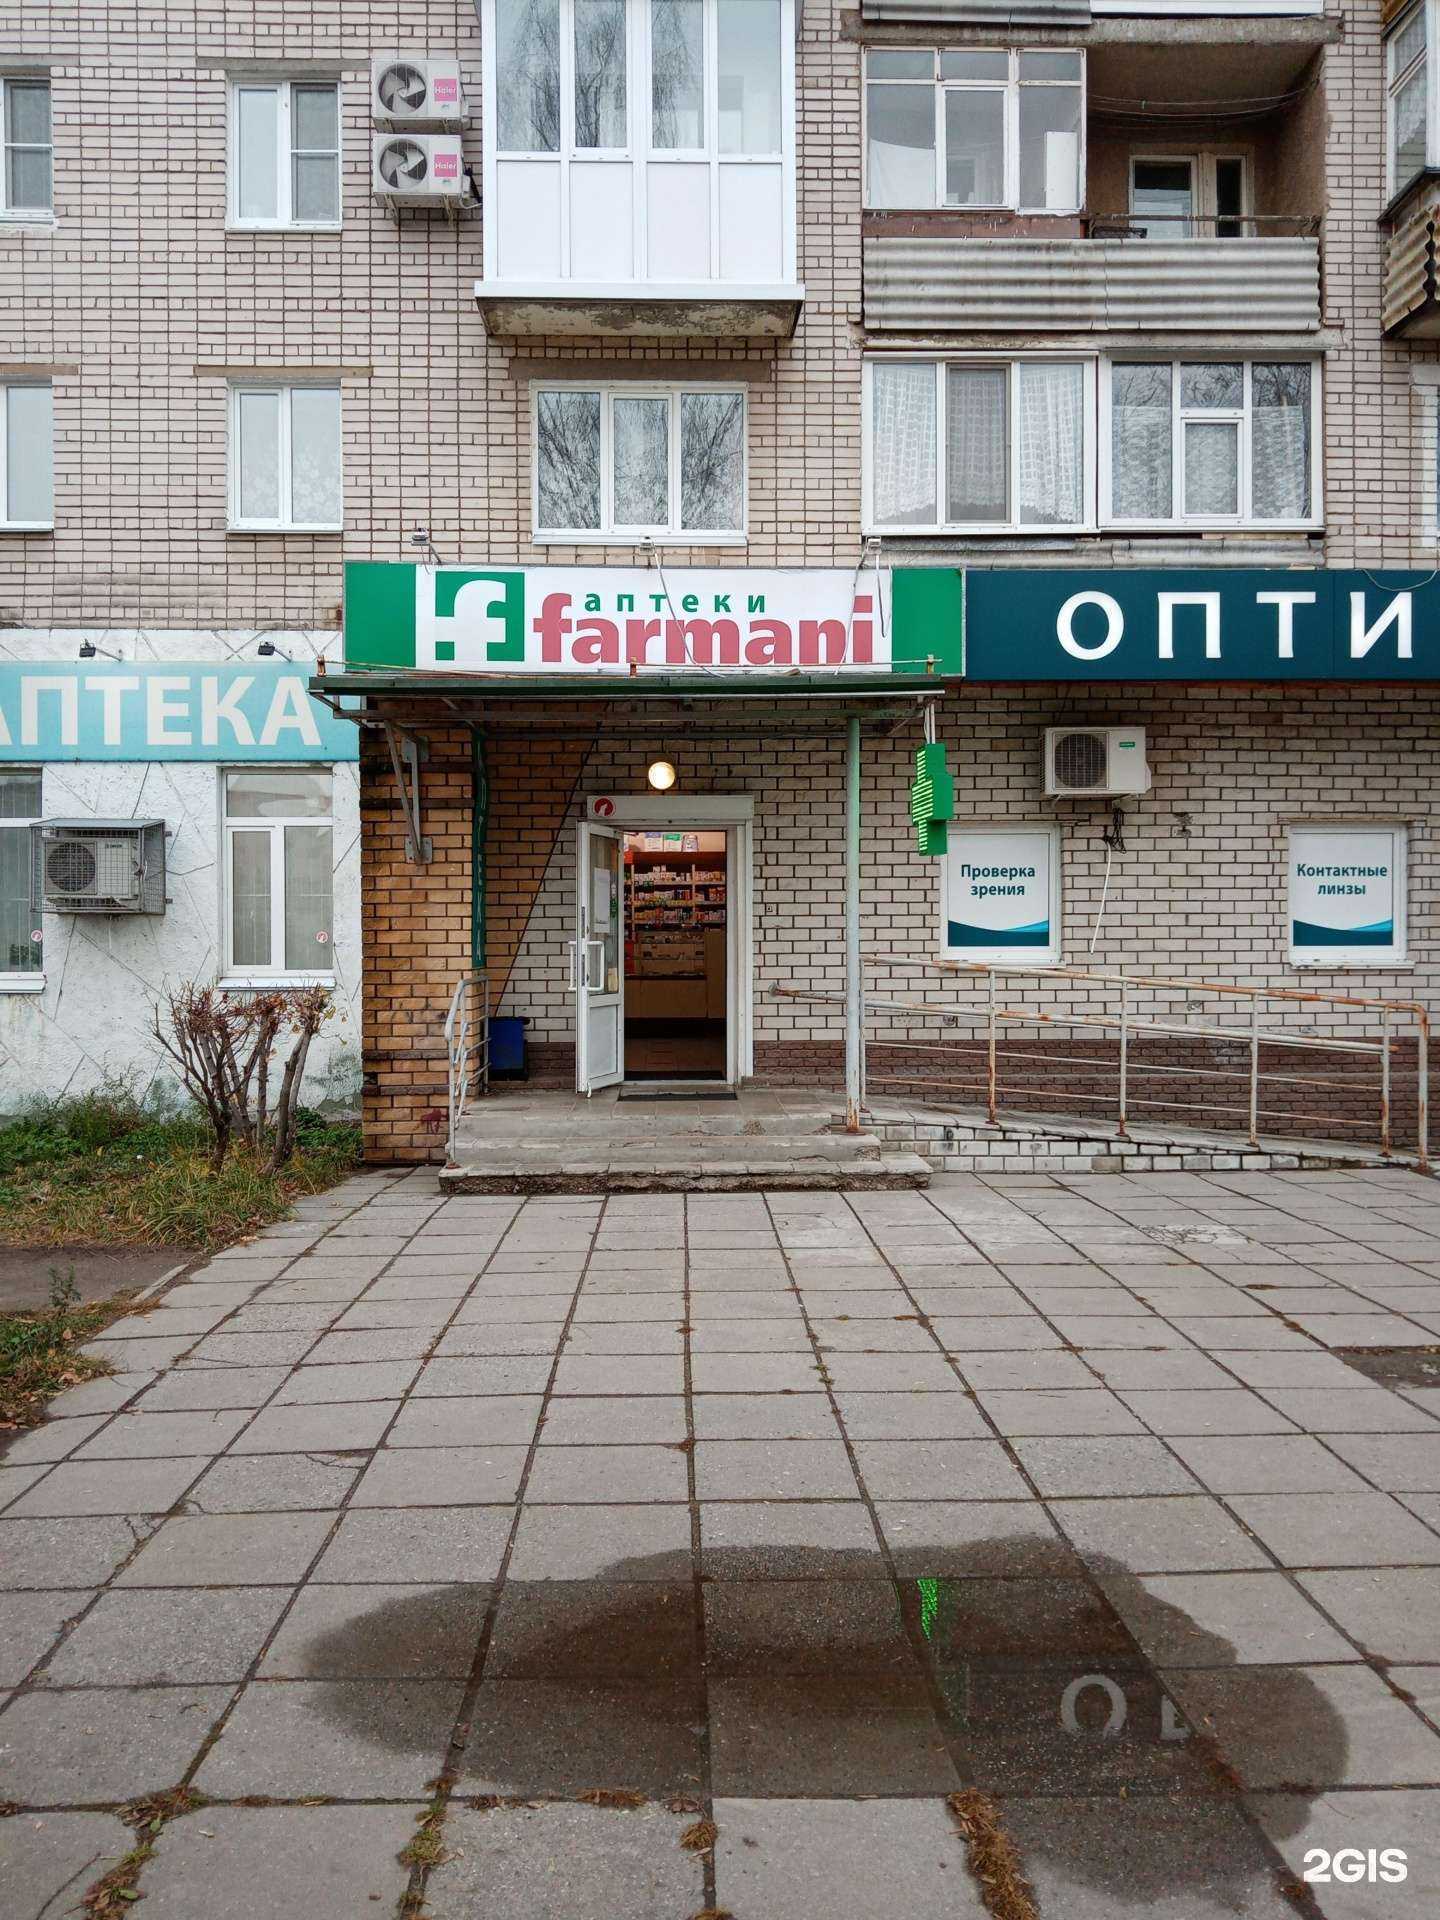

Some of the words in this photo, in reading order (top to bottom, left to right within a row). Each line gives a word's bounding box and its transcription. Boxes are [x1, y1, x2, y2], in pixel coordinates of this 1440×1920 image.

[584, 592, 767, 613] аптеки
[532, 592, 873, 664] farmani
[1056, 590, 1413, 660] ОПТИ
[0, 676, 322, 745] ПТЕКА
[961, 864, 1036, 881] Проверка
[1297, 864, 1388, 877] Контактные
[970, 885, 1025, 899] зрения
[1317, 885, 1366, 895] линзы
